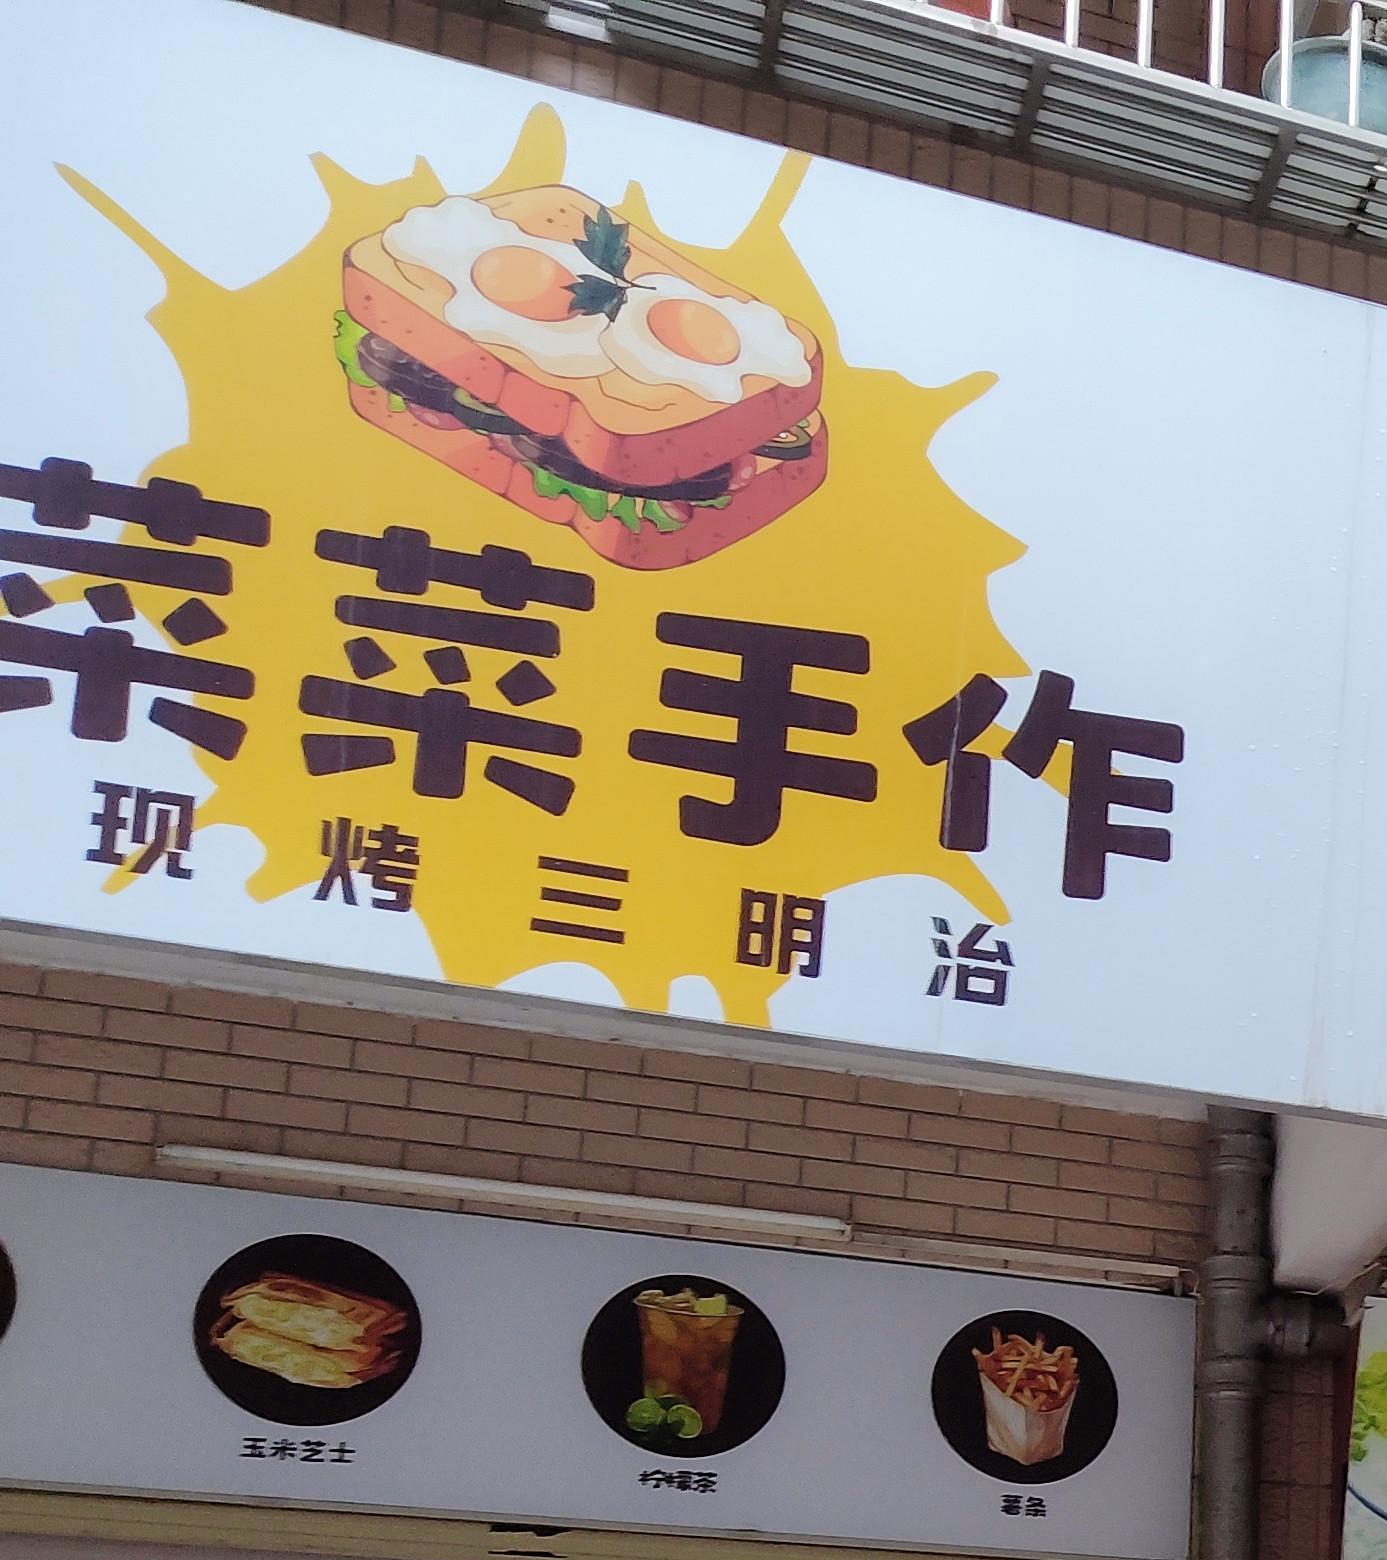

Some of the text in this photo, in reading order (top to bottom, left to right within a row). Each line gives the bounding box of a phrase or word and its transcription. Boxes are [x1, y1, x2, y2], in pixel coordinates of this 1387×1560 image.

[0, 457, 1184, 900] 菜菜手作
[85, 780, 1016, 1007] 现烤三明治
[239, 1436, 356, 1464] 玉米芝士
